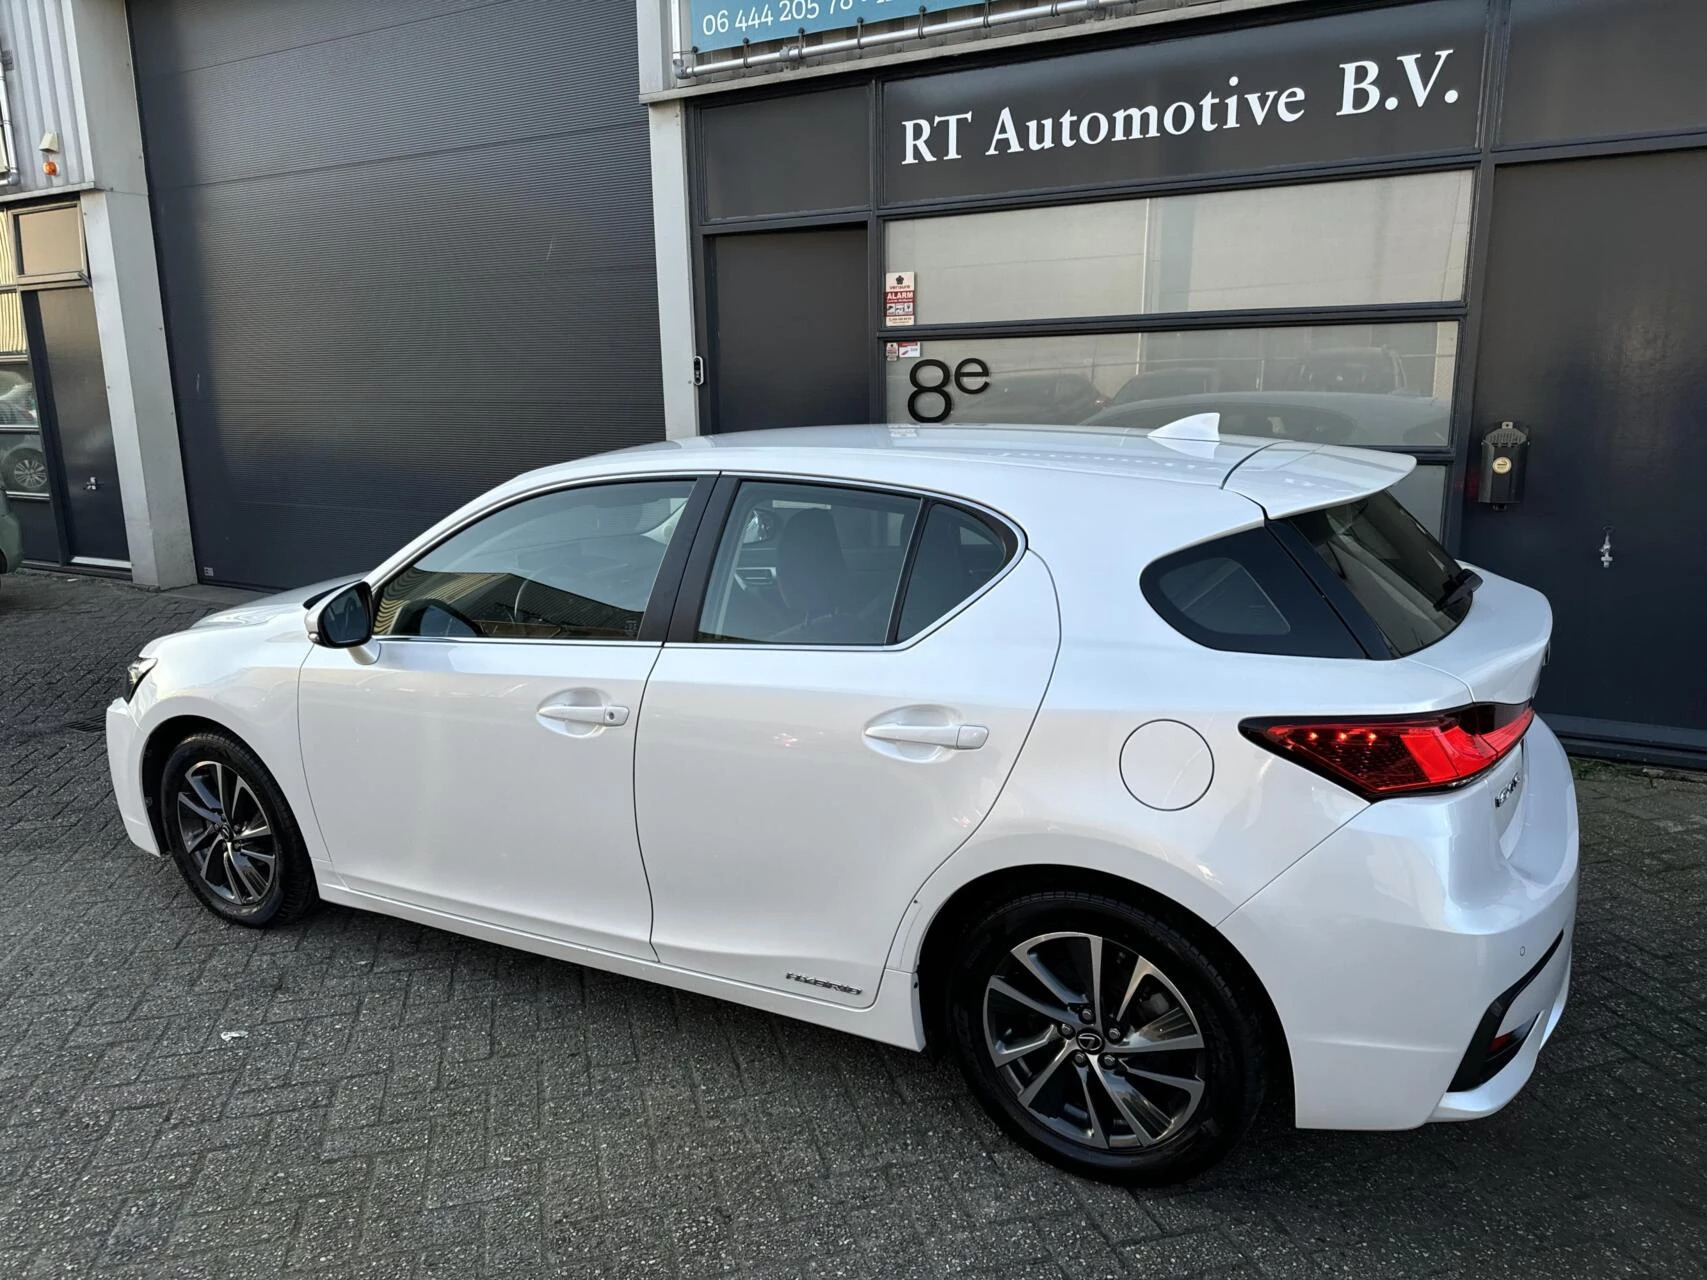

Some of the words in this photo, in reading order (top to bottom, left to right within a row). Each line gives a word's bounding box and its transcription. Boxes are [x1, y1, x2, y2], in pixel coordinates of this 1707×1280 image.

[702, 9, 729, 36] 06
[734, 3, 774, 32] 444
[778, 0, 820, 22] 205
[901, 110, 973, 165] RT
[985, 76, 1306, 156] Automotive
[1336, 49, 1459, 116] B.V.
[887, 291, 914, 300] ALARM
